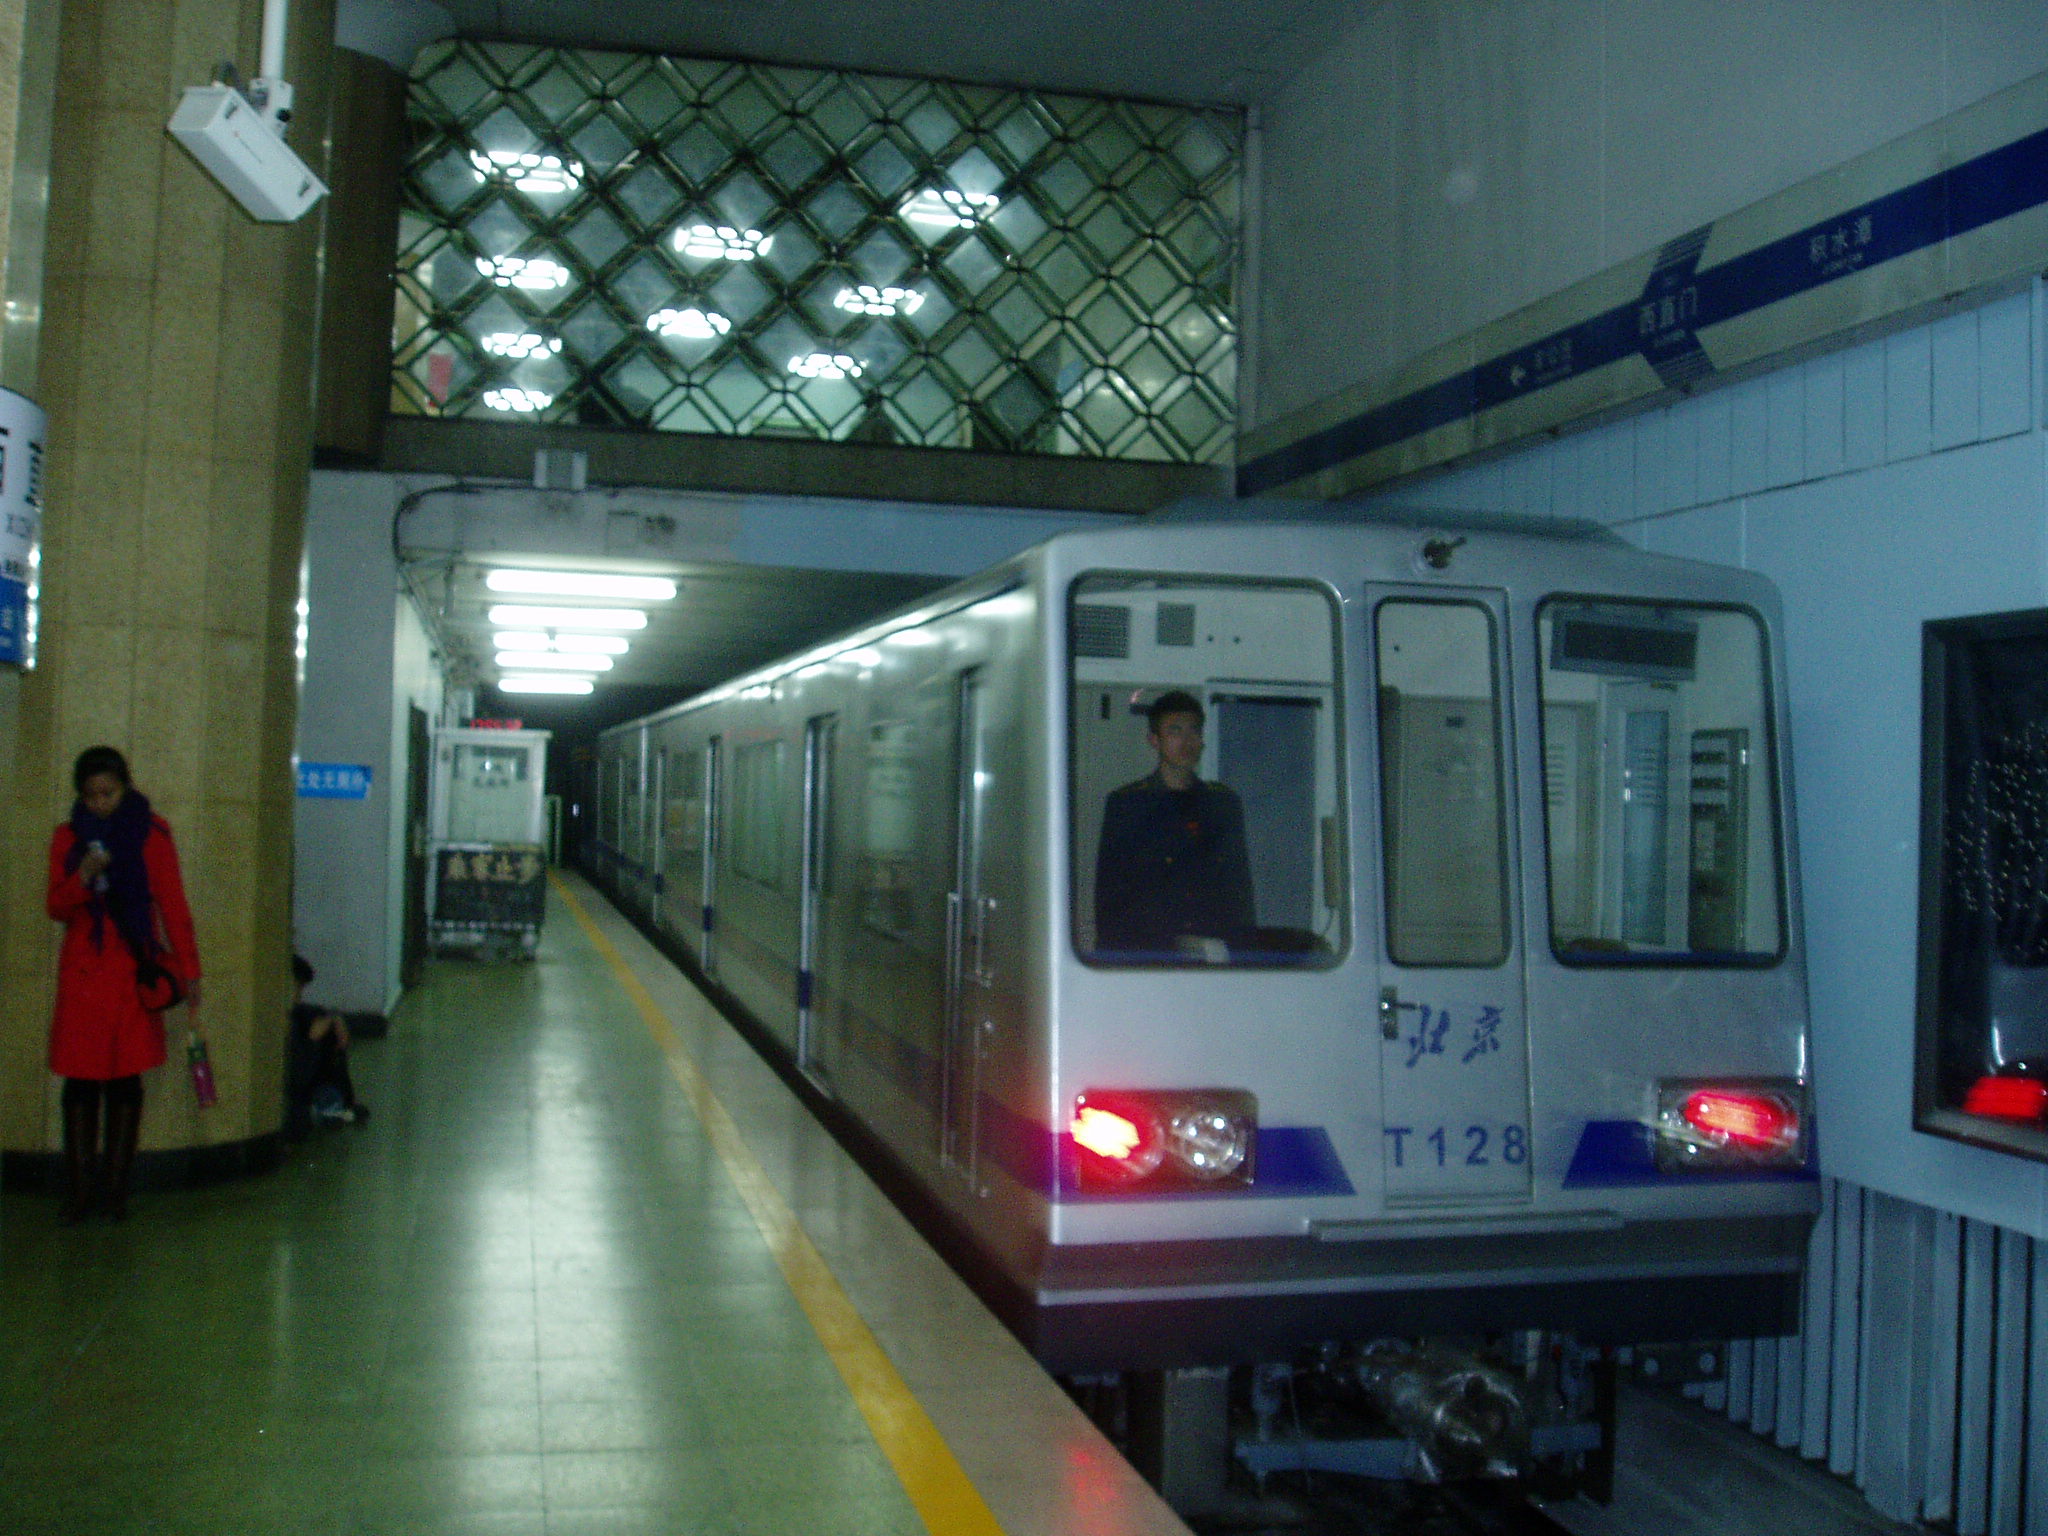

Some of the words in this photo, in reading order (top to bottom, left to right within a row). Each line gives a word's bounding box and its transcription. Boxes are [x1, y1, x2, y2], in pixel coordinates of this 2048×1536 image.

[1639, 285, 1698, 336] 西直门
[1383, 1124, 1526, 1168] T128
